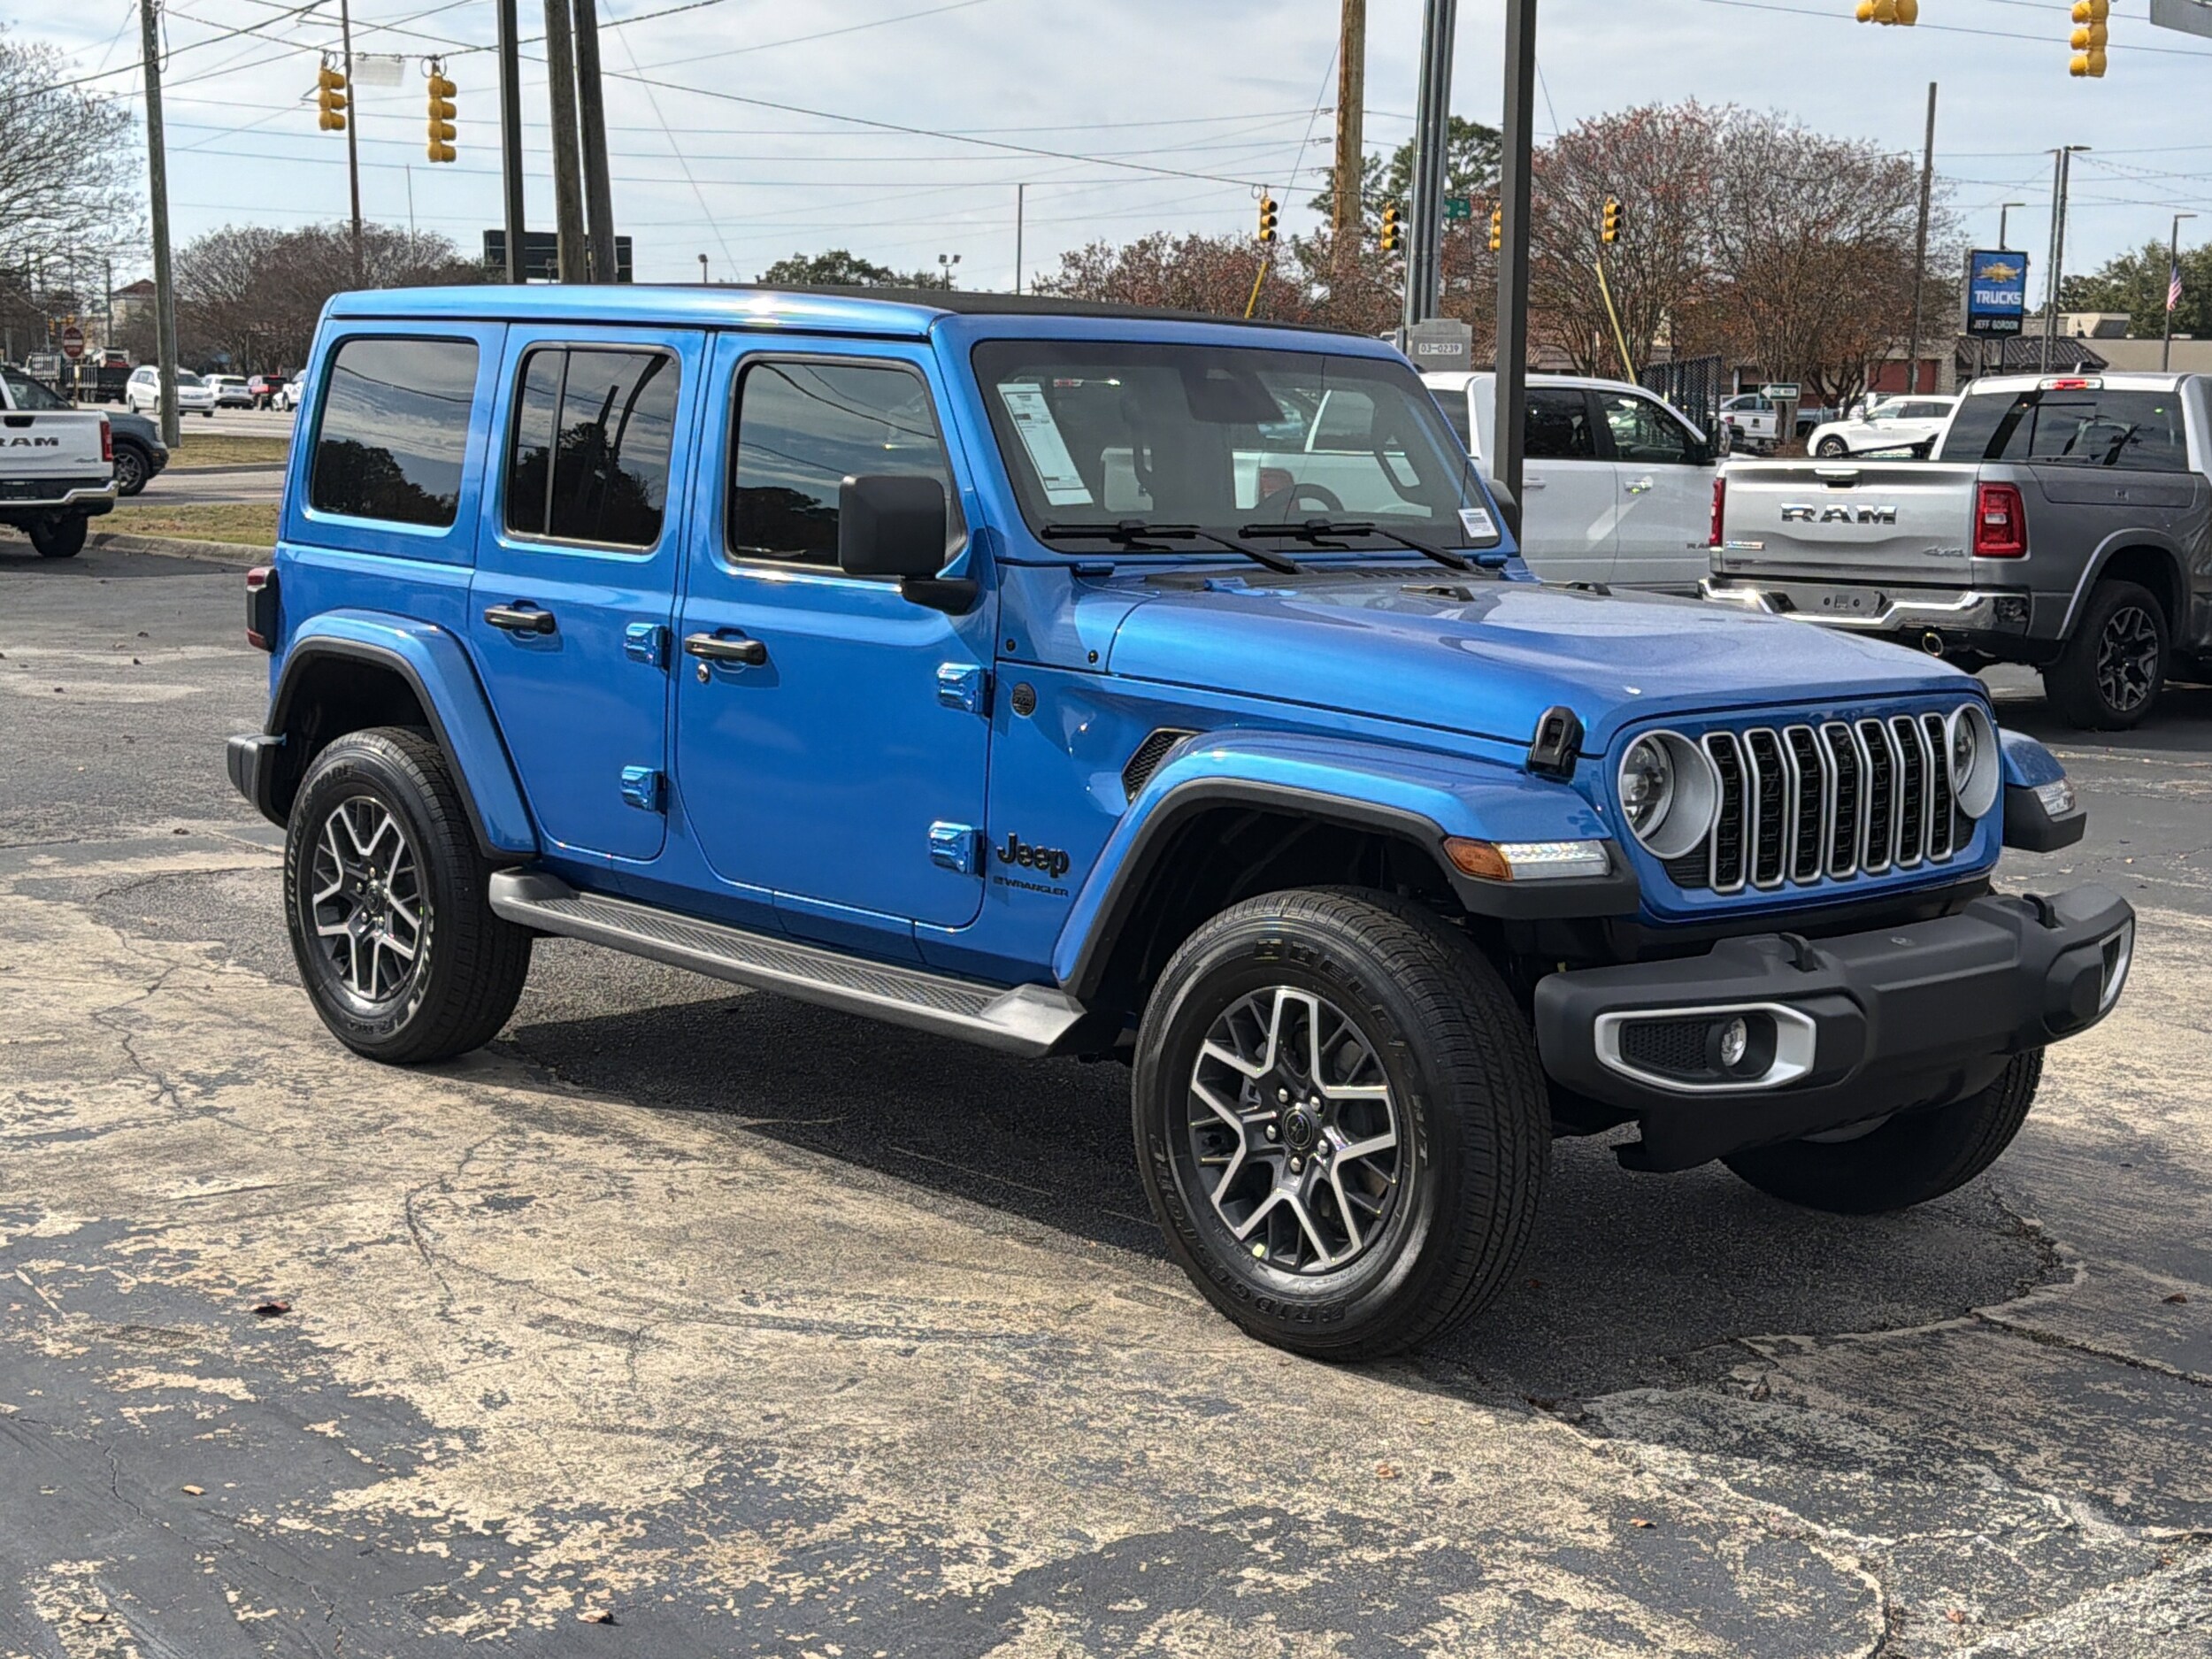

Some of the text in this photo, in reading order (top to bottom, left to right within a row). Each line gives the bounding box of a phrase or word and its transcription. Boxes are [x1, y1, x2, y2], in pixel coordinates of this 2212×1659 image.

[1974, 290, 2023, 305] TRUCKS
[1974, 319, 1991, 330] JEFF
[1421, 344, 1460, 353] 03-0239
[1780, 503, 1898, 526] RAM
[996, 832, 1070, 879] Jeep
[1004, 877, 1069, 897] WRANGLER
